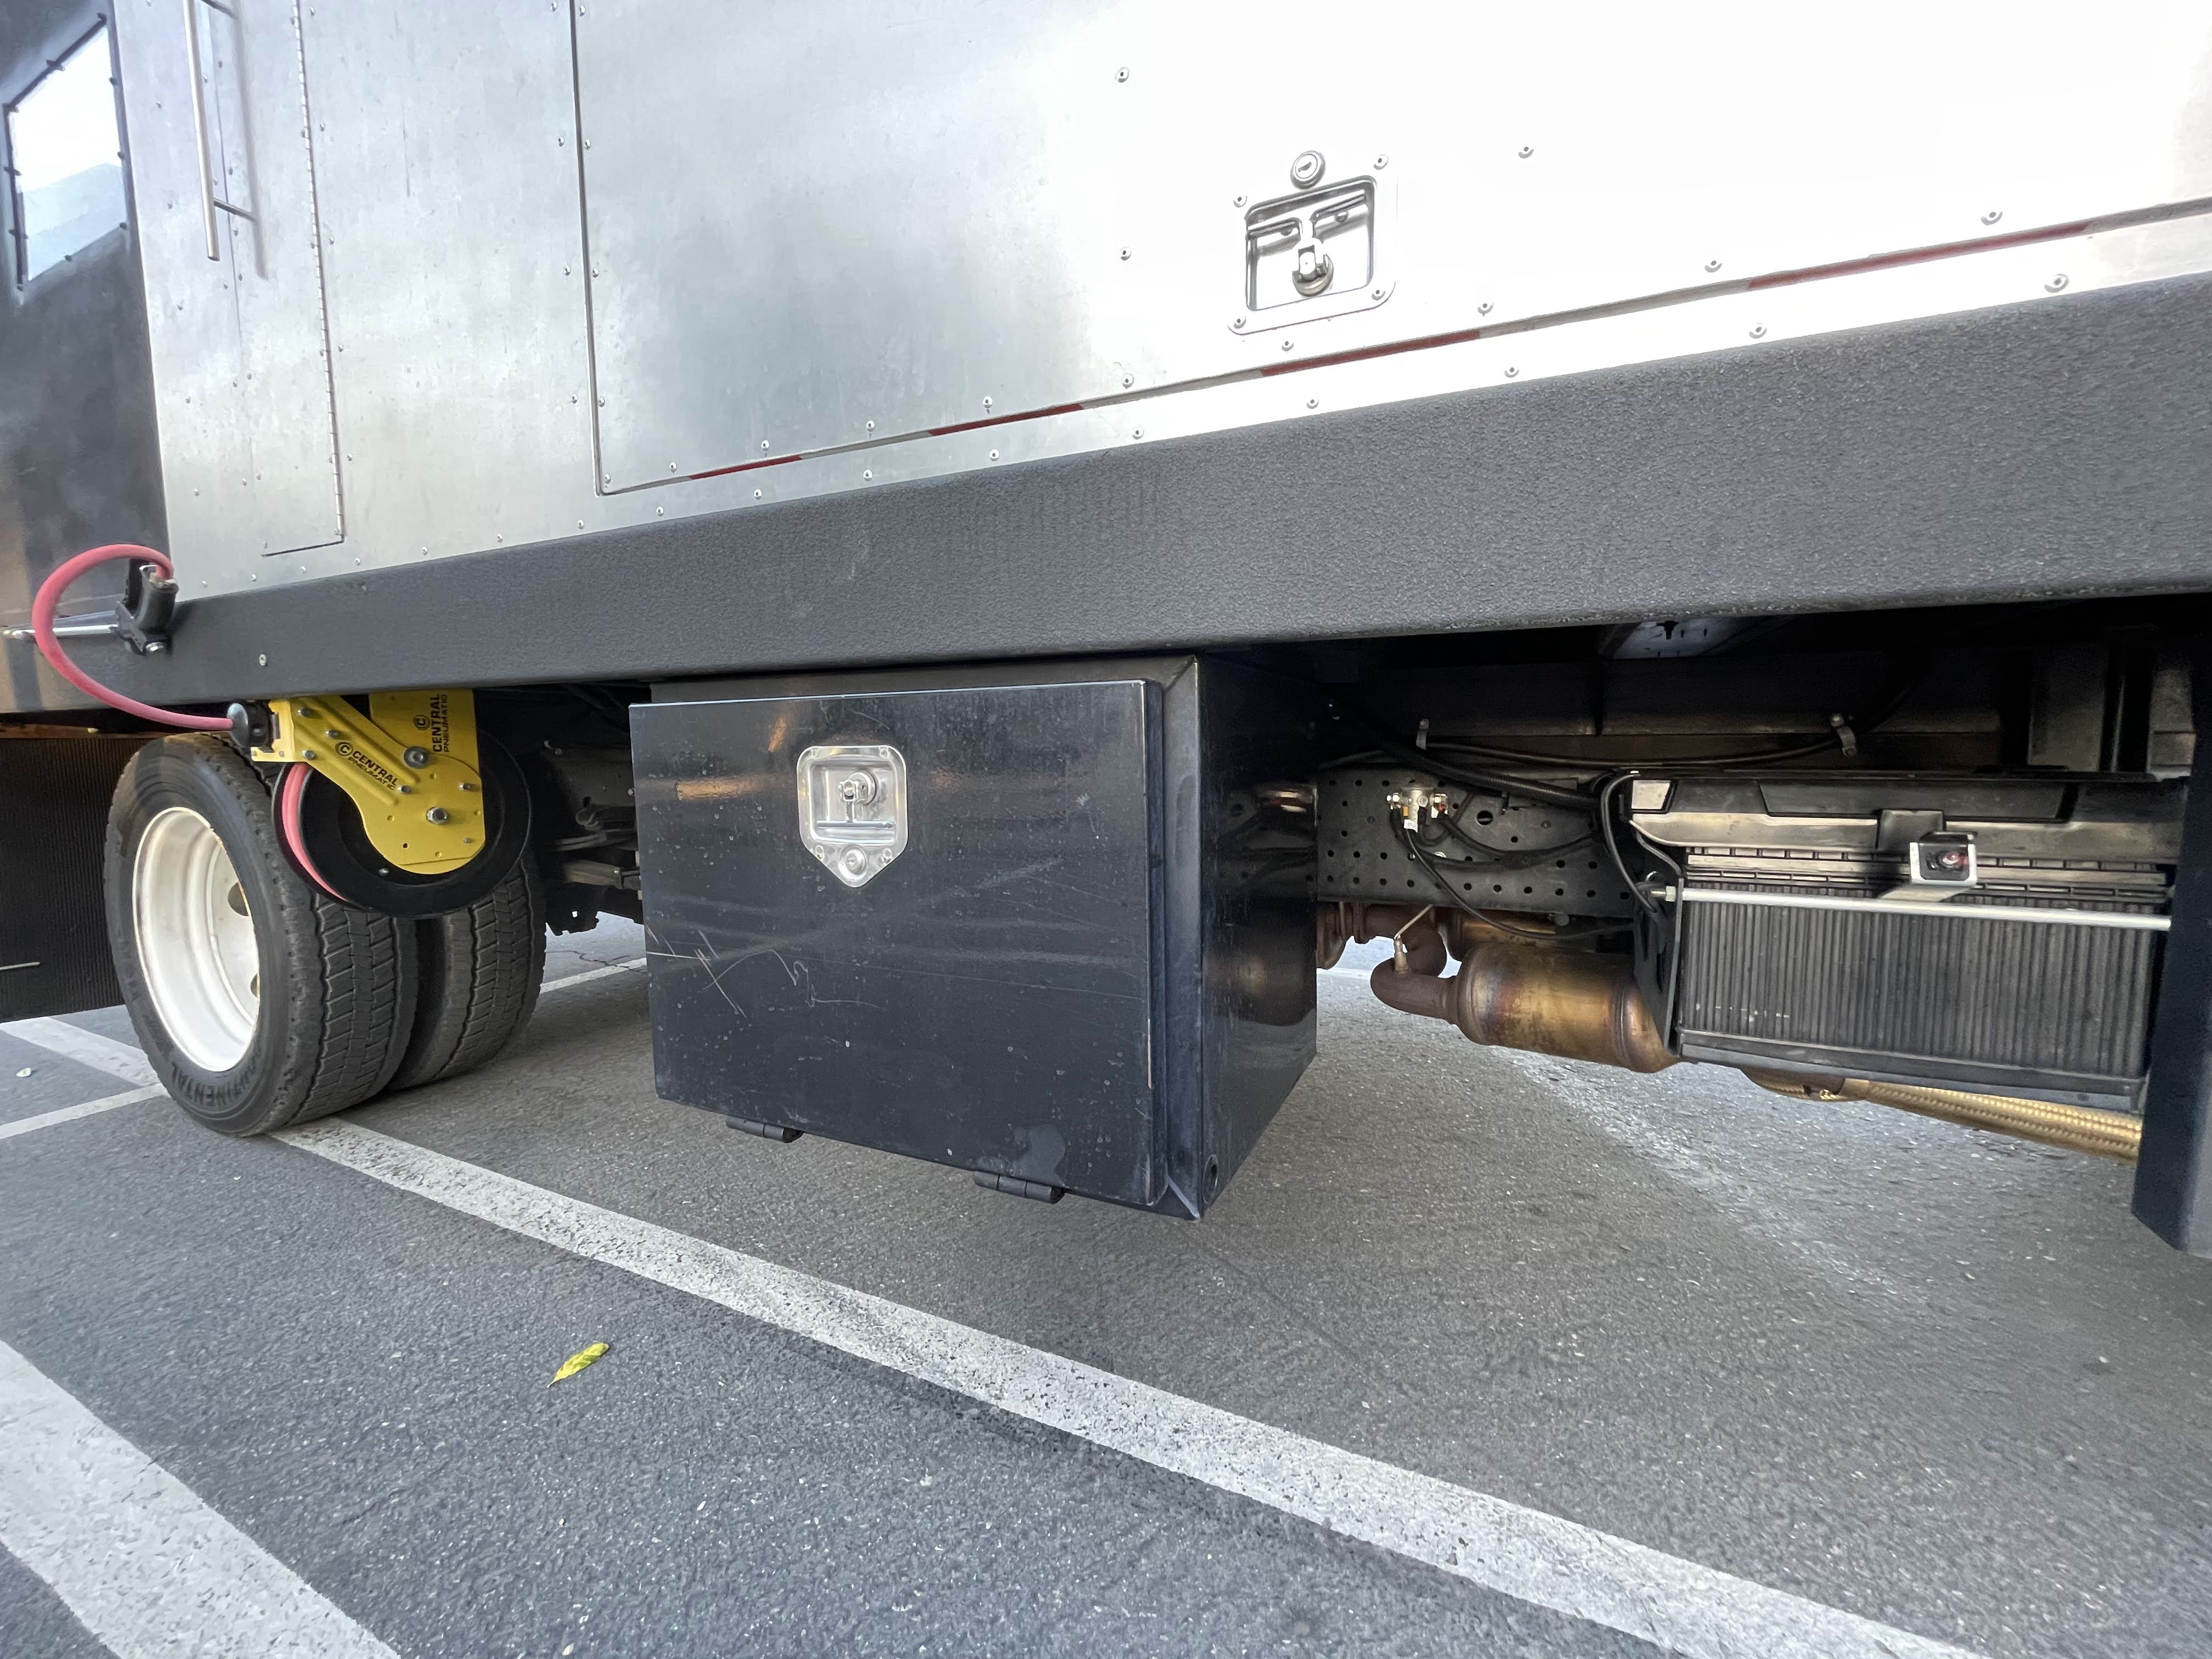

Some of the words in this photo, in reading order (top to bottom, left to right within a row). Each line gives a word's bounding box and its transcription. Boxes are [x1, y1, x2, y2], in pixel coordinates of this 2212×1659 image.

[430, 693, 442, 752] CENTRAL
[441, 695, 449, 752] PNEUMATIC
[348, 757, 396, 790] PNEUMATIC
[352, 751, 397, 786] CENTRAL
